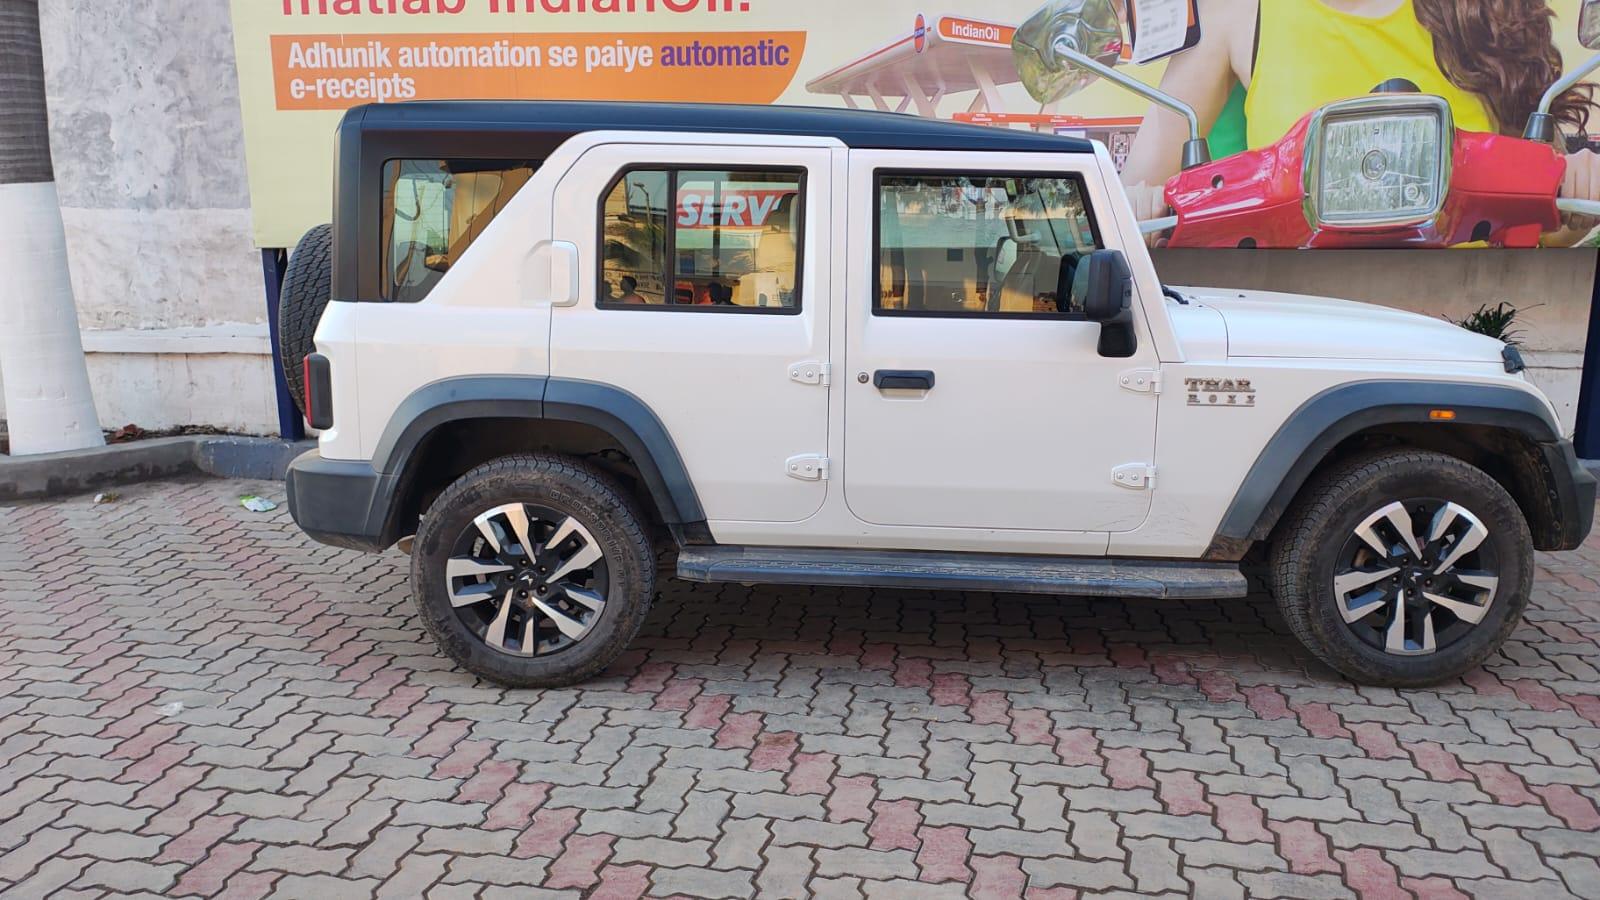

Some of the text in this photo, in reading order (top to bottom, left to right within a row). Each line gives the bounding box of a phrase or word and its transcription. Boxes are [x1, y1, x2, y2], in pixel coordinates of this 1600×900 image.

[952, 22, 1000, 41] IndianOil
[288, 39, 790, 73] Adhunik automation se paiye automatic
[290, 72, 416, 102] e-receipts
[677, 194, 783, 226] SERV
